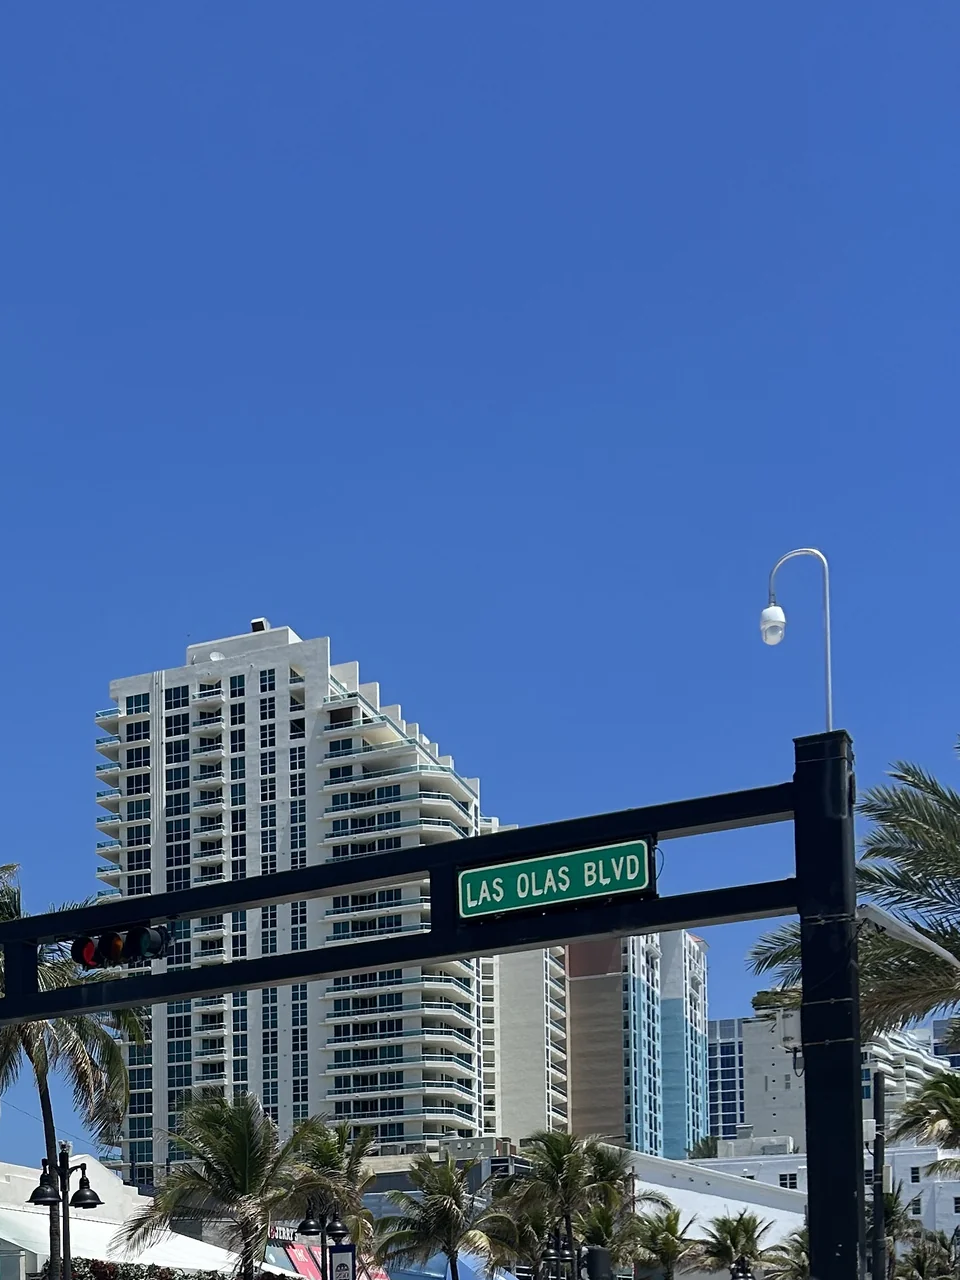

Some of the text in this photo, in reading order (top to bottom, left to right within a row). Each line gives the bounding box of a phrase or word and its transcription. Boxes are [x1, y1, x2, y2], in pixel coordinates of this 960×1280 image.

[467, 855, 640, 908] LAS OLAS BLVD
